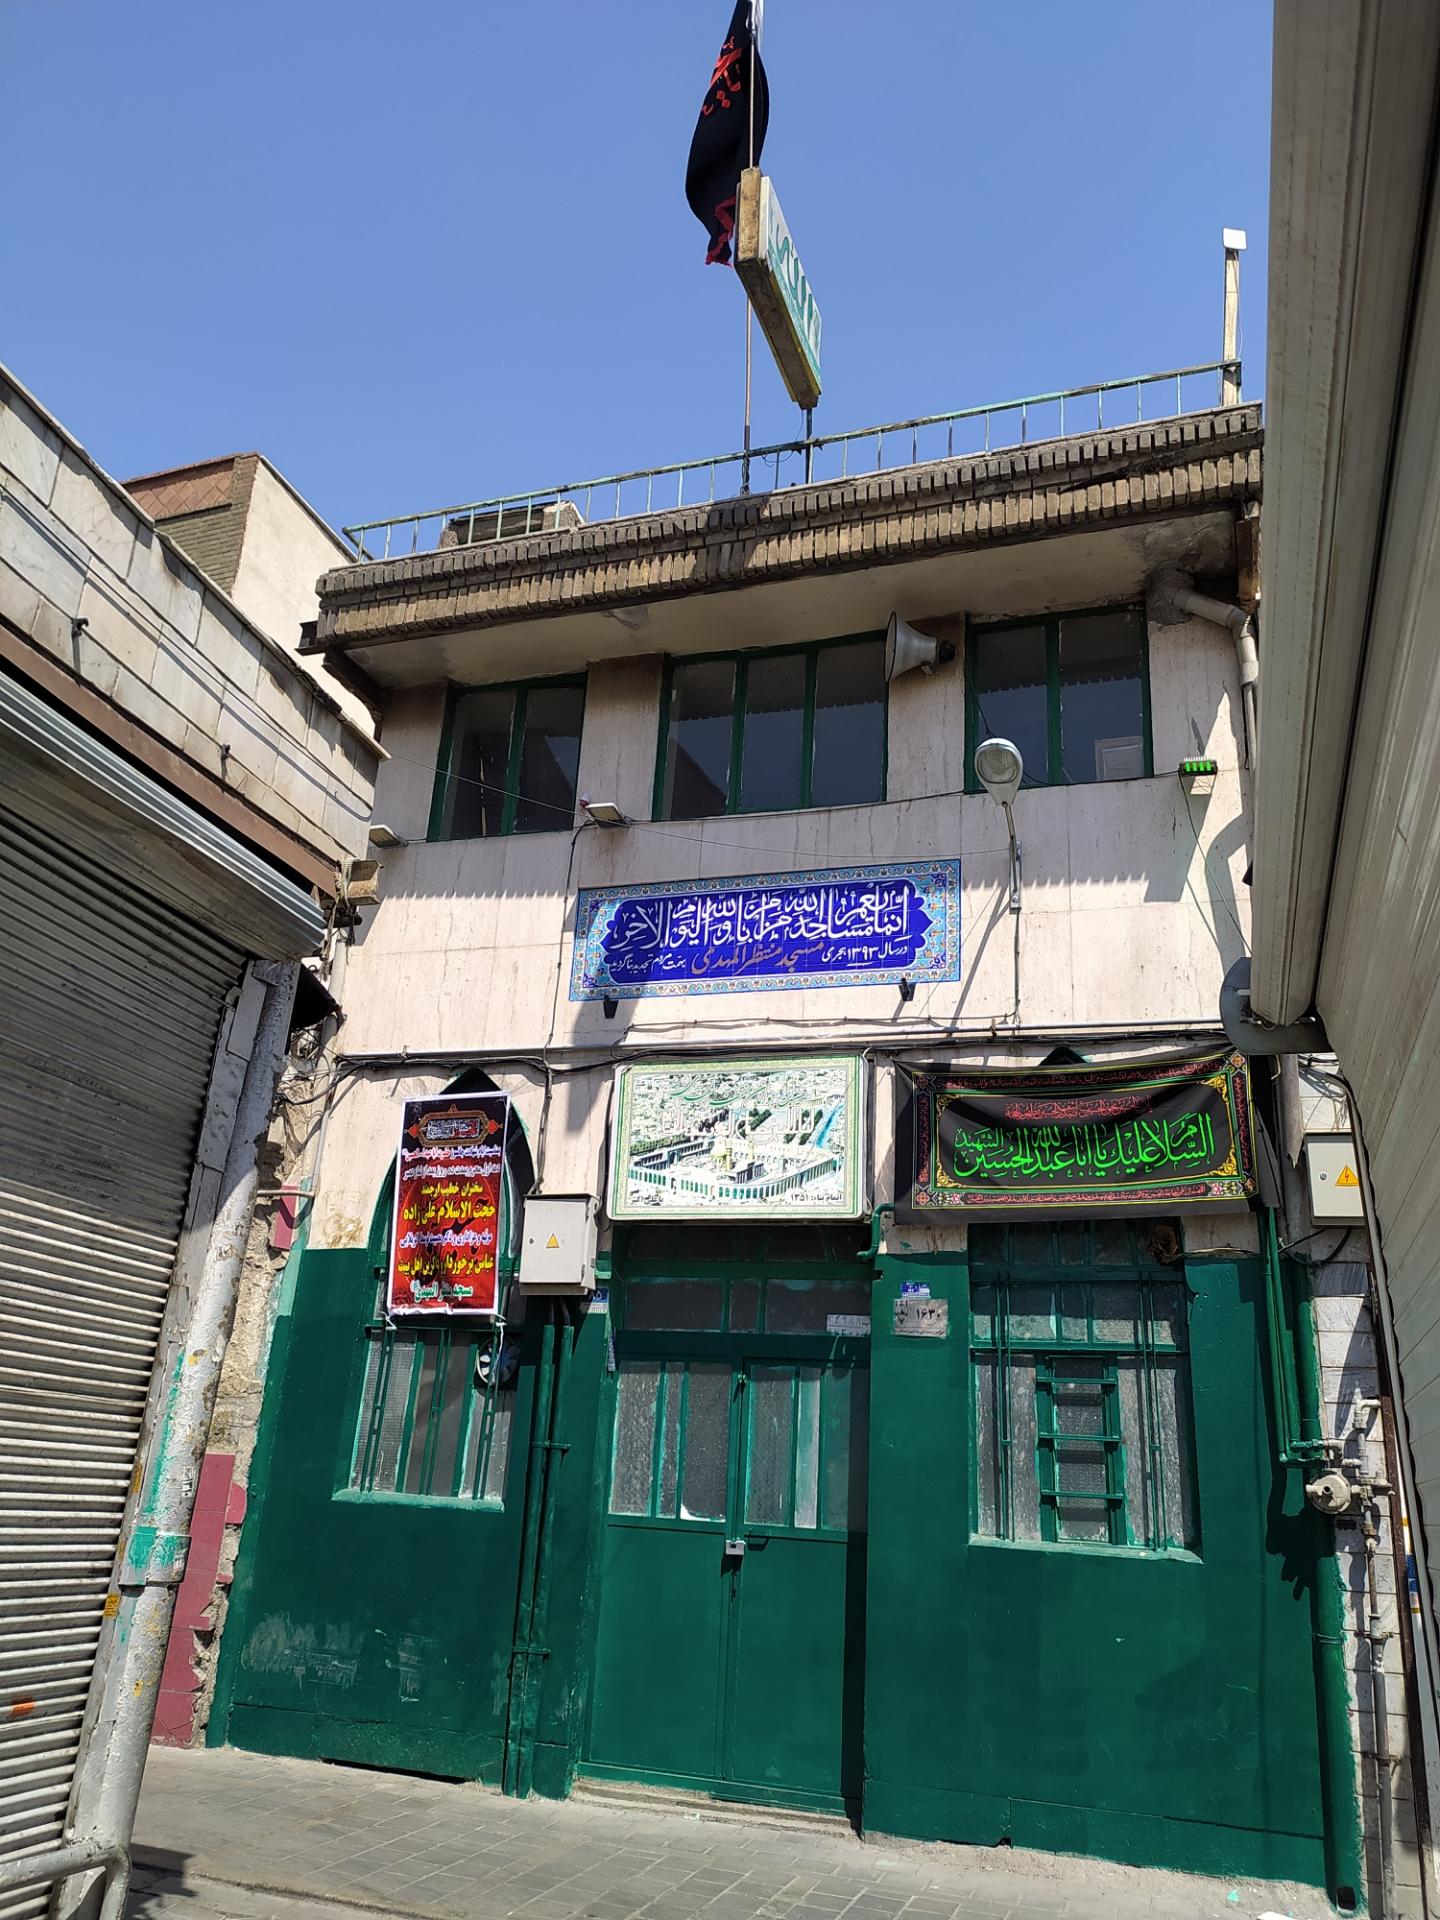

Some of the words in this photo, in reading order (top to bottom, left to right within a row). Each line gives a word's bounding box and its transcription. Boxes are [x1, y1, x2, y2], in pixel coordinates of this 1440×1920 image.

[733, 943, 783, 976] منتظر
[775, 941, 825, 973] مسجد
[822, 946, 848, 962] هجری
[847, 946, 878, 960] ۱۳۹۳
[954, 1126, 1004, 1153] الشهید
[1153, 1111, 1215, 1167] السلام
[954, 1126, 1034, 1178] الحسین
[421, 1182, 441, 1198] ارجمند
[441, 1182, 460, 1198] خطیب
[461, 1181, 483, 1197] سخنران
[438, 1200, 472, 1224] الاسلام
[473, 1204, 495, 1221] حجت
[398, 1260, 410, 1275] بیت
[411, 1256, 422, 1276] اهل
[475, 1253, 493, 1274] عباس
[453, 1283, 473, 1301] مسجد
[916, 1308, 940, 1320] ۱۶۳۰
